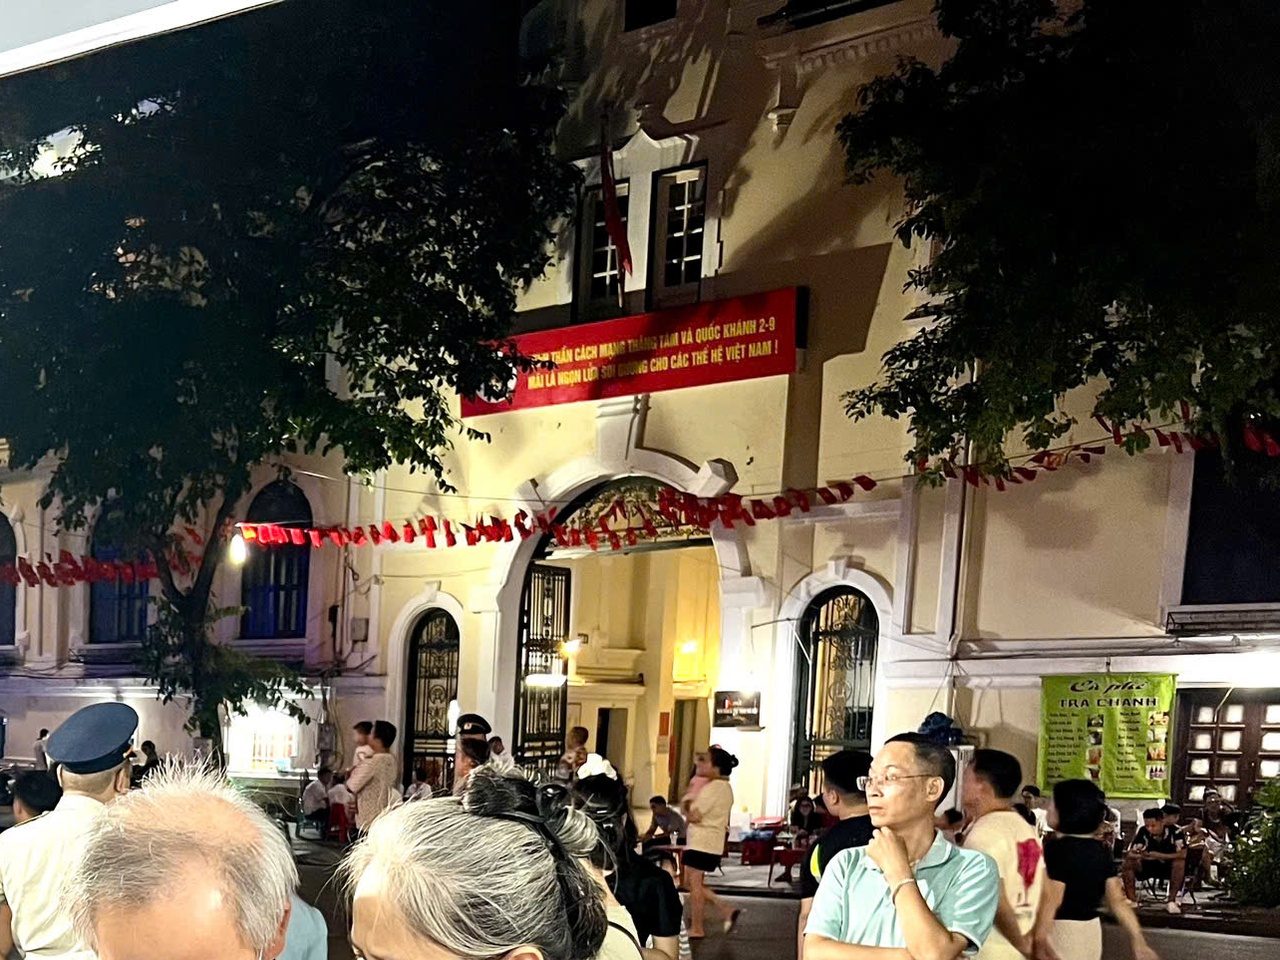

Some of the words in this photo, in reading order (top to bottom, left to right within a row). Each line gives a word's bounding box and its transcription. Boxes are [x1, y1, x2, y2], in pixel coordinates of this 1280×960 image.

[545, 370, 556, 387] LÀ
[650, 356, 668, 372] CHO
[670, 351, 689, 368] CÁC
[691, 344, 709, 366] THẾ
[711, 345, 724, 365] HỆ
[726, 342, 746, 363] VIỆT
[749, 340, 771, 357] NAM
[551, 345, 573, 364] THẦN
[575, 344, 597, 361] CÁCH
[599, 341, 625, 359] MẠNG
[660, 333, 679, 348] TÁM
[681, 327, 693, 344] VÀ
[695, 320, 721, 343] QUỐC
[723, 319, 757, 338] KHÁNH
[759, 316, 776, 332] 2-9
